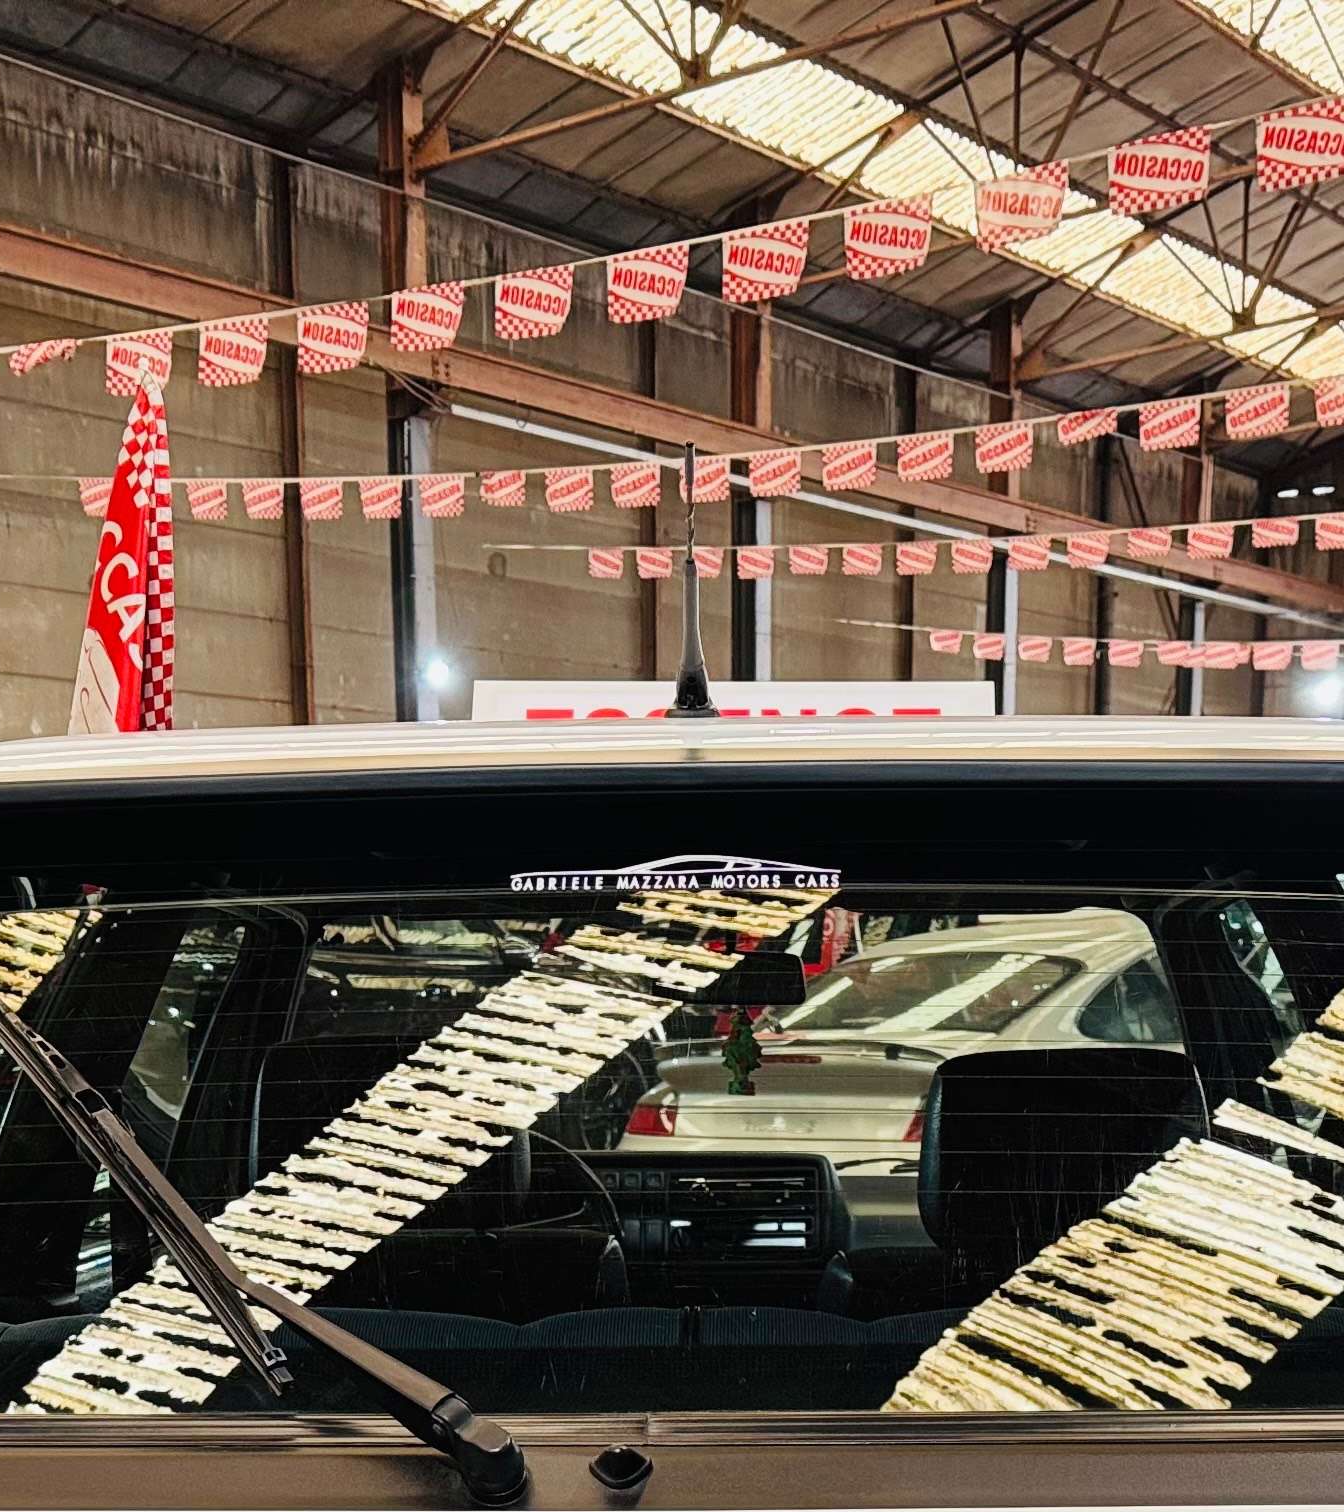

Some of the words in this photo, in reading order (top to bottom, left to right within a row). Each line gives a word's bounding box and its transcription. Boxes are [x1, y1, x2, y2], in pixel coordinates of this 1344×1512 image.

[1143, 408, 1197, 440] OCCASION
[1230, 392, 1286, 428] OCCASION
[510, 876, 604, 891] GABRIELE
[616, 875, 699, 890] MAZZARA
[710, 874, 781, 889] MOTORS
[794, 873, 841, 888] CARS
